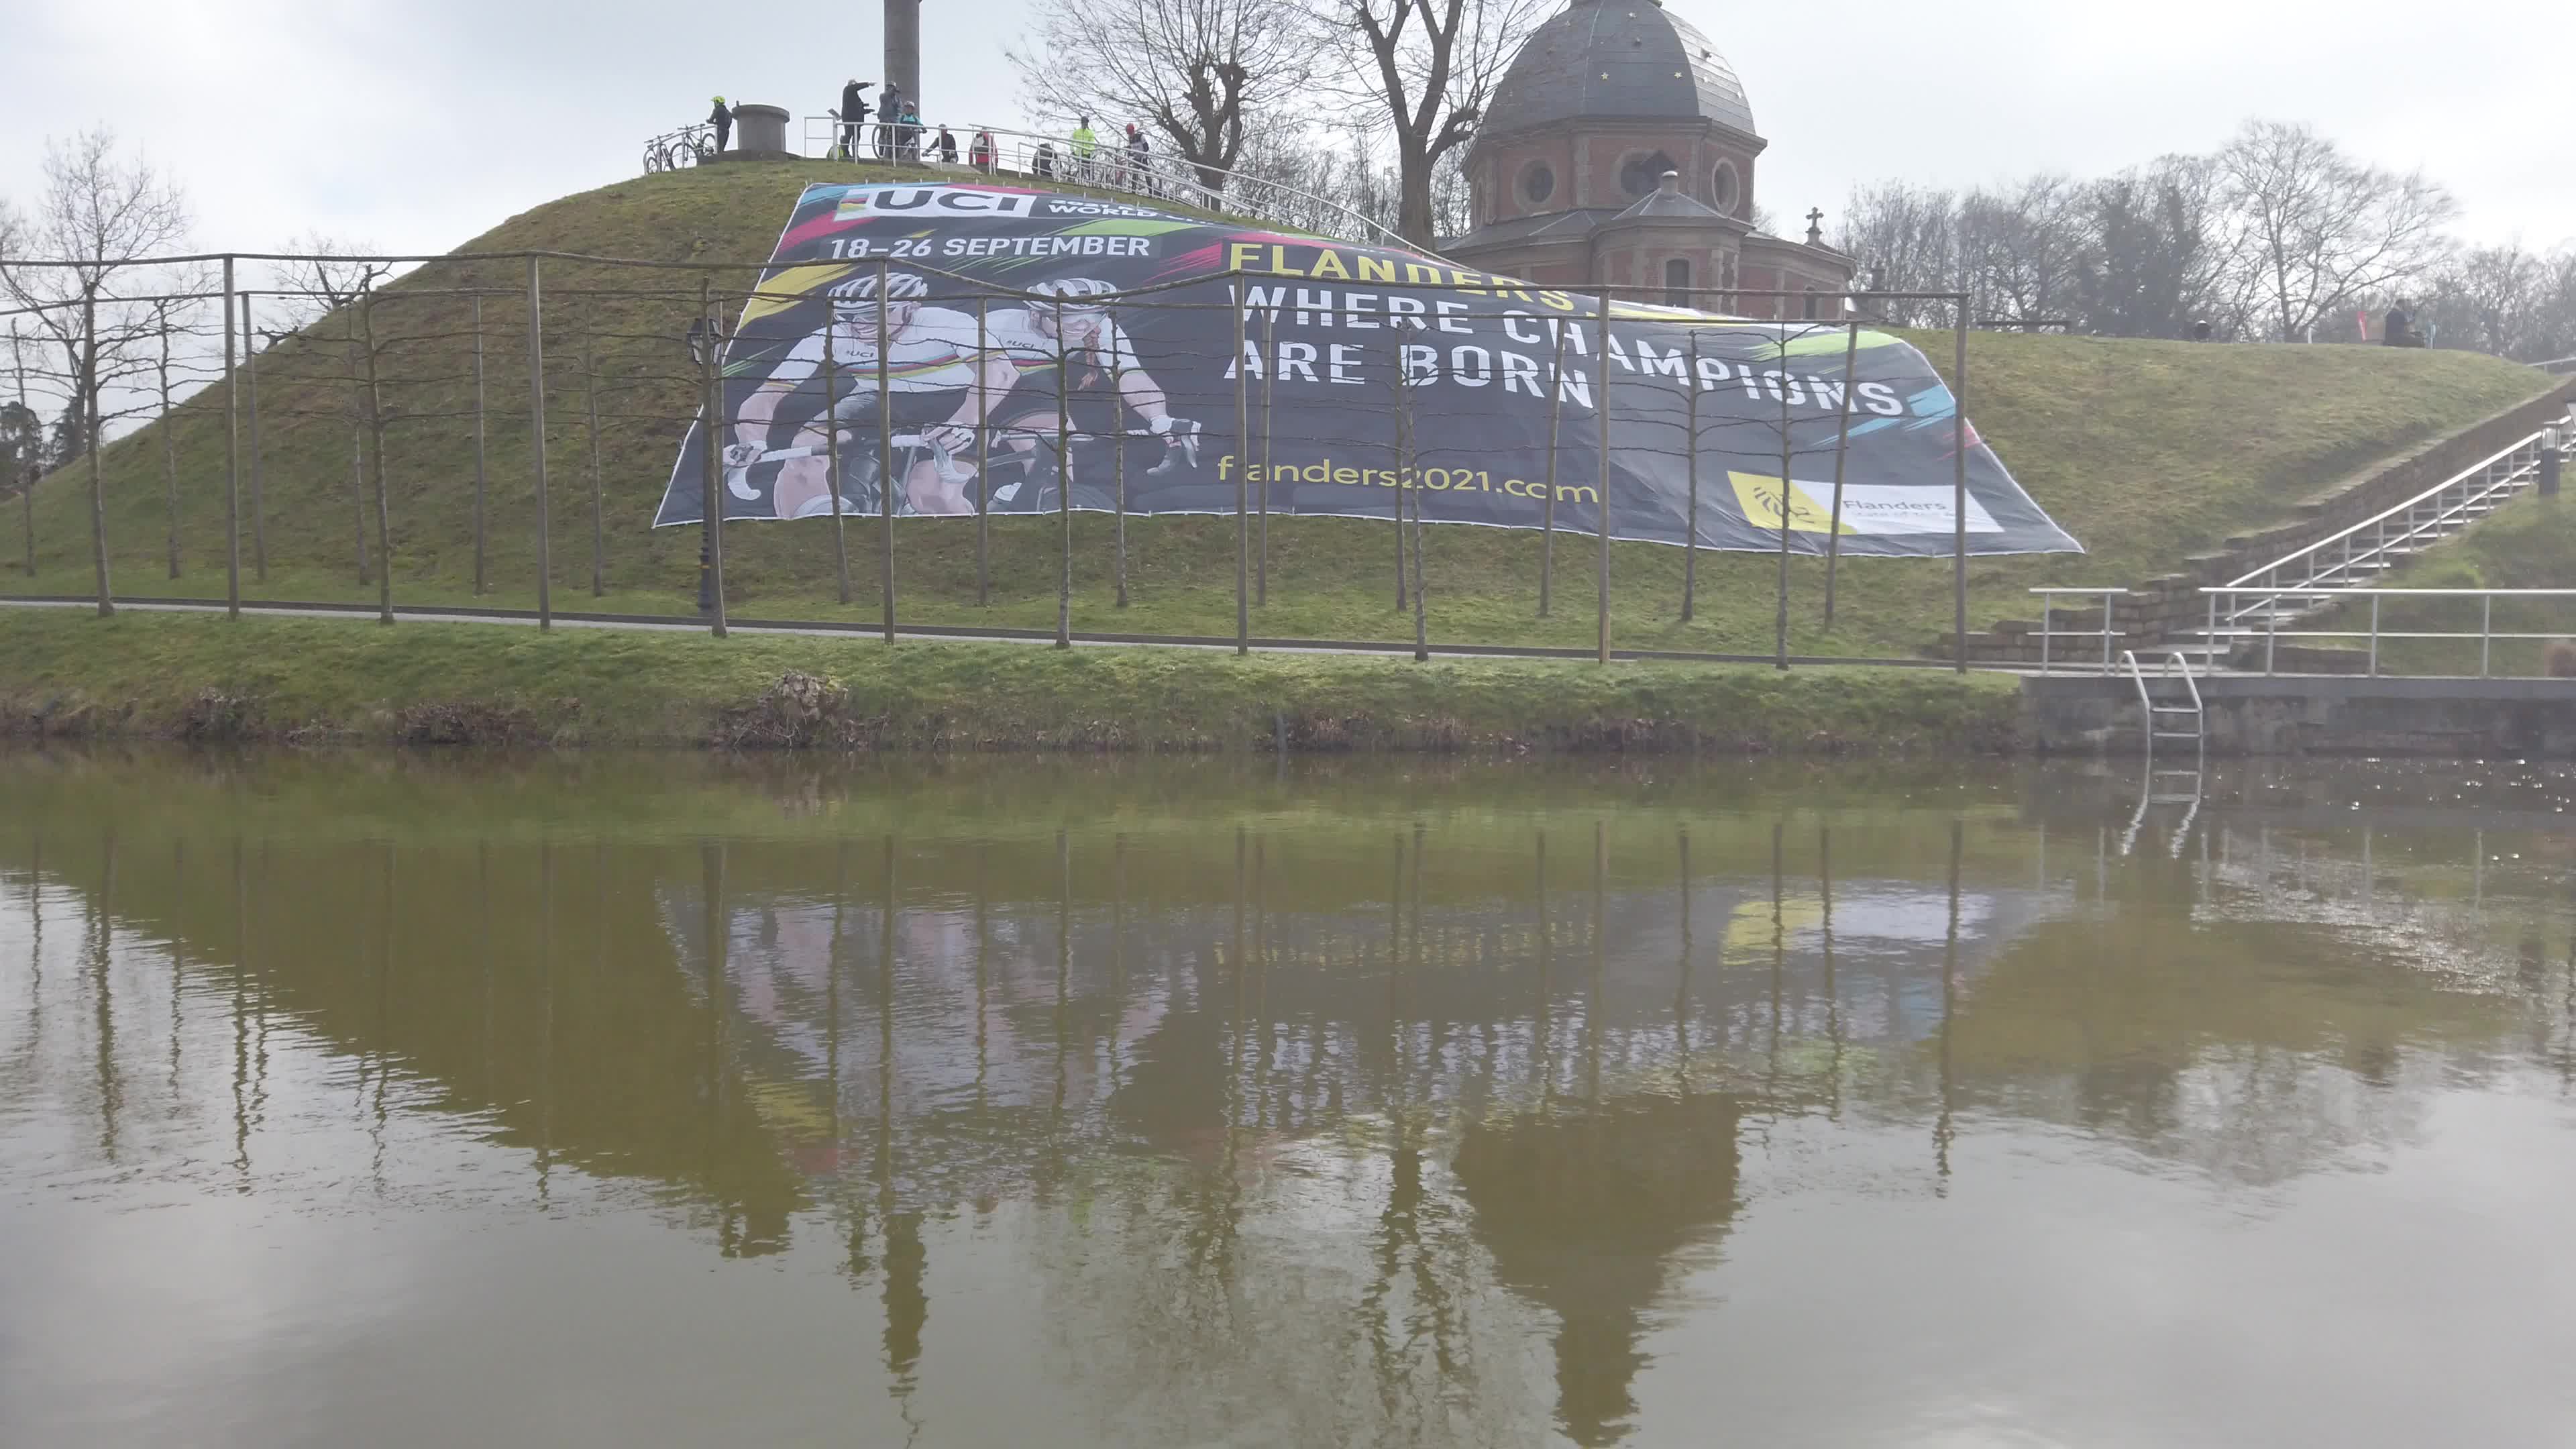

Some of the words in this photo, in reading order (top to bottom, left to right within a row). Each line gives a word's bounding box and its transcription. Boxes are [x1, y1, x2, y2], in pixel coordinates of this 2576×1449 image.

[873, 190, 1020, 211] UCI
[1048, 205, 1159, 217] WORLD
[943, 237, 1150, 257] SEPTEMBER
[1228, 285, 1474, 334] WHERE
[1502, 309, 1903, 416] CHAMPIONS
[1224, 339, 1366, 384] ARE
[1399, 344, 1593, 409] BORN
[1218, 455, 1598, 502] fanders2021.com
[1842, 500, 1947, 510] Flanders
